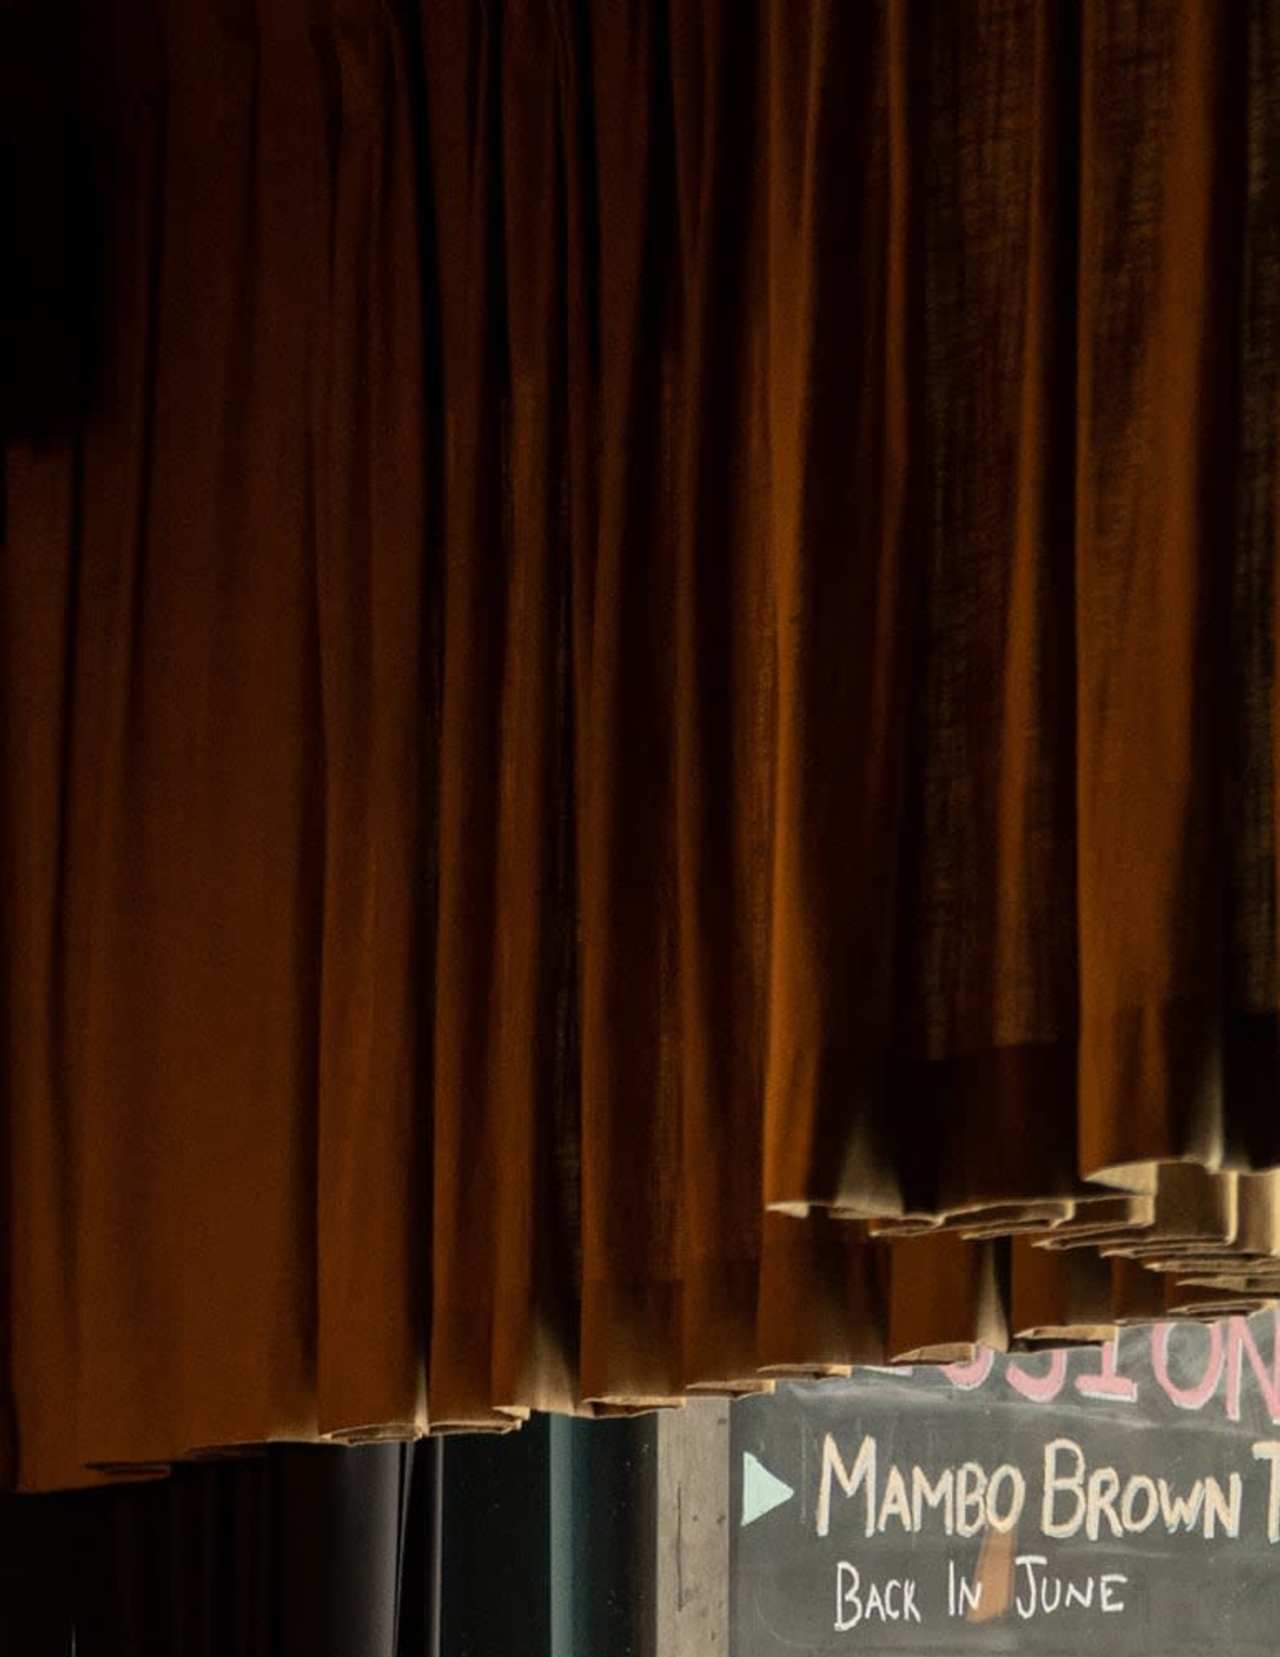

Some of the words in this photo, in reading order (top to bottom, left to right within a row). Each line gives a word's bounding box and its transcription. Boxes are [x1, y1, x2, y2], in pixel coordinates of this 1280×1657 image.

[817, 1431, 1026, 1537] MAMBO
[1041, 1437, 1243, 1541] BROWN
[834, 1560, 921, 1631] BACK
[1014, 1554, 1128, 1620] JUNE
